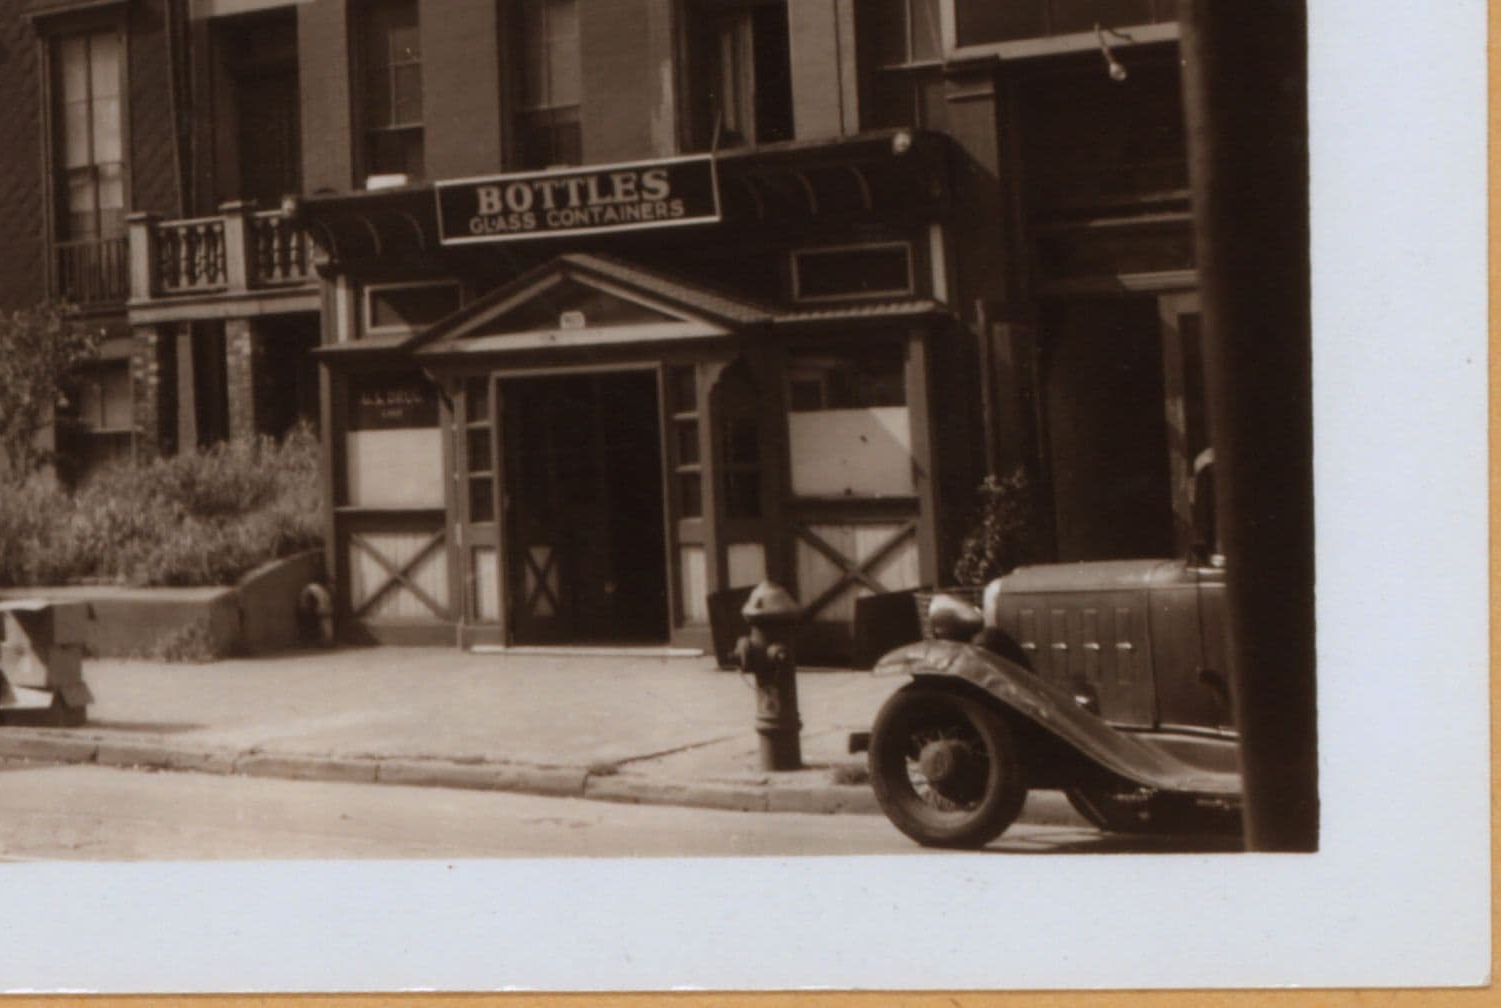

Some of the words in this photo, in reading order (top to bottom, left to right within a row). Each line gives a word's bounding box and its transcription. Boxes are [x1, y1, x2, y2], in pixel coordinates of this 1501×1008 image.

[477, 170, 670, 215] BOTTLES
[469, 212, 536, 234] GLASS
[546, 199, 685, 226] CONTAINERS
